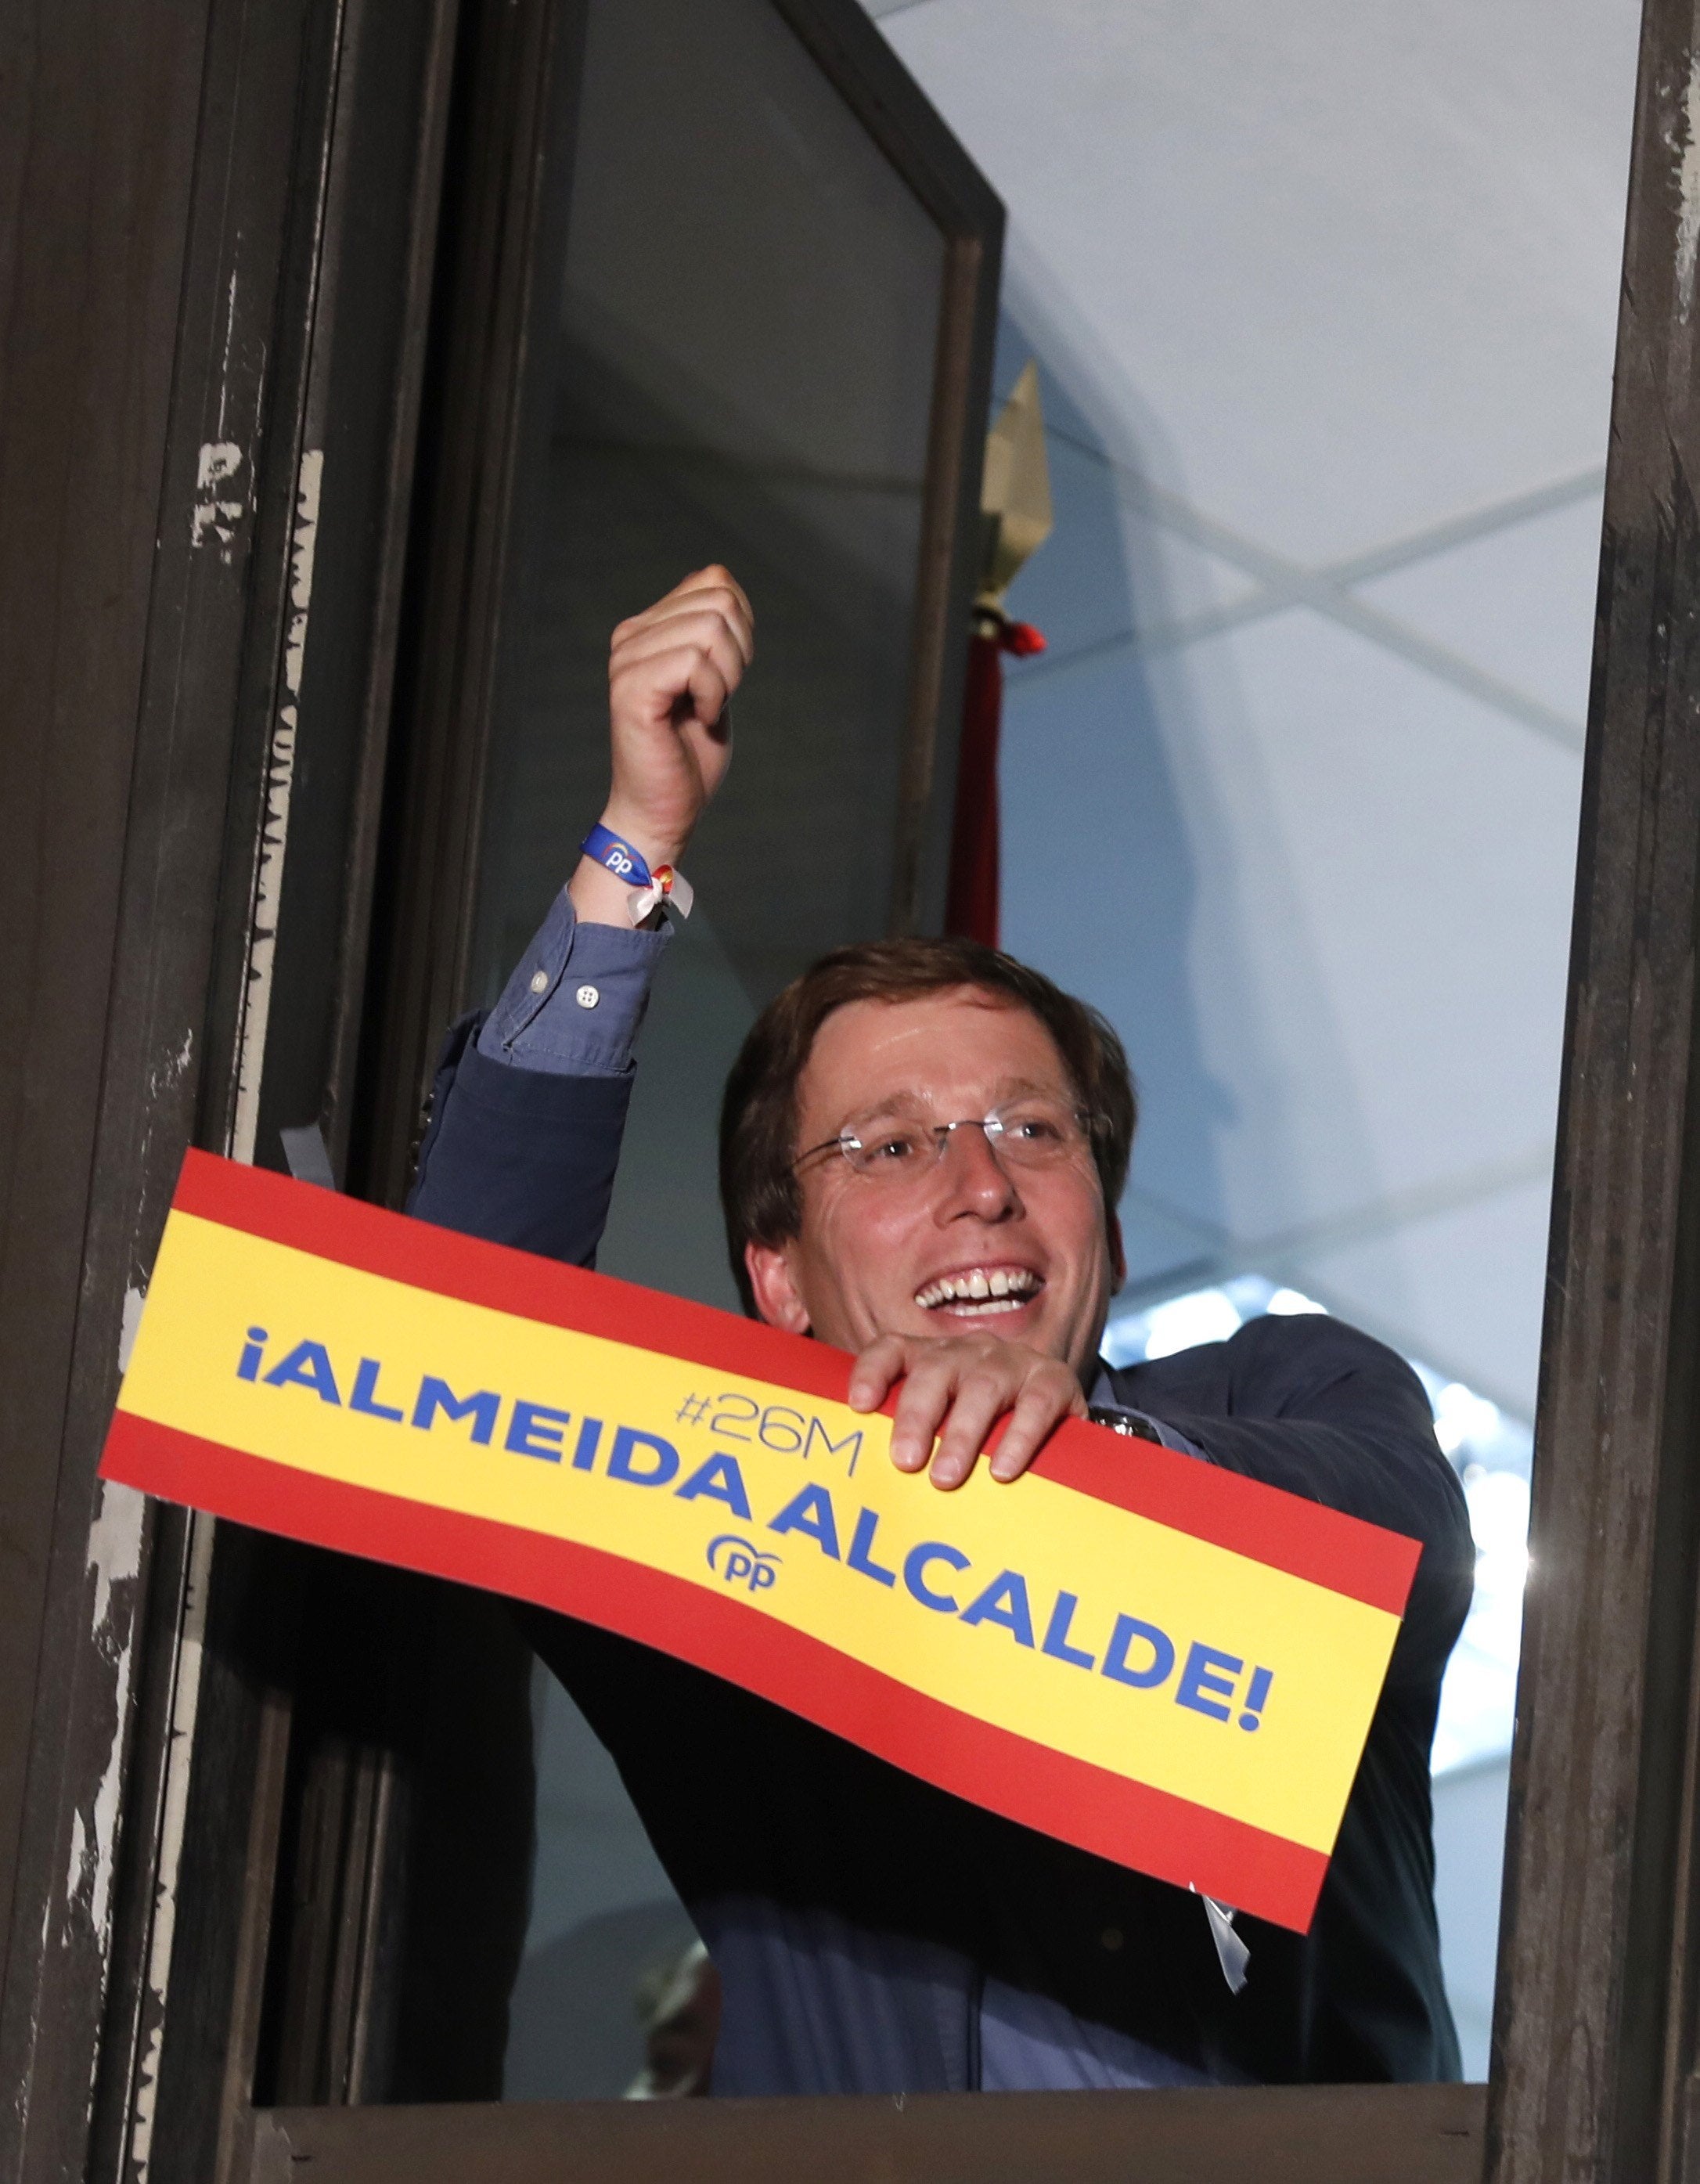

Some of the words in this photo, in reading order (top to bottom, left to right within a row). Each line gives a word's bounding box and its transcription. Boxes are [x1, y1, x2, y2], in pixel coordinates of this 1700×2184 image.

[606, 852, 632, 874] pp
[675, 1393, 863, 1478] #26M
[237, 1327, 753, 1521] ¡ALMEIDA
[766, 1482, 1273, 1732] ALCALDE!
